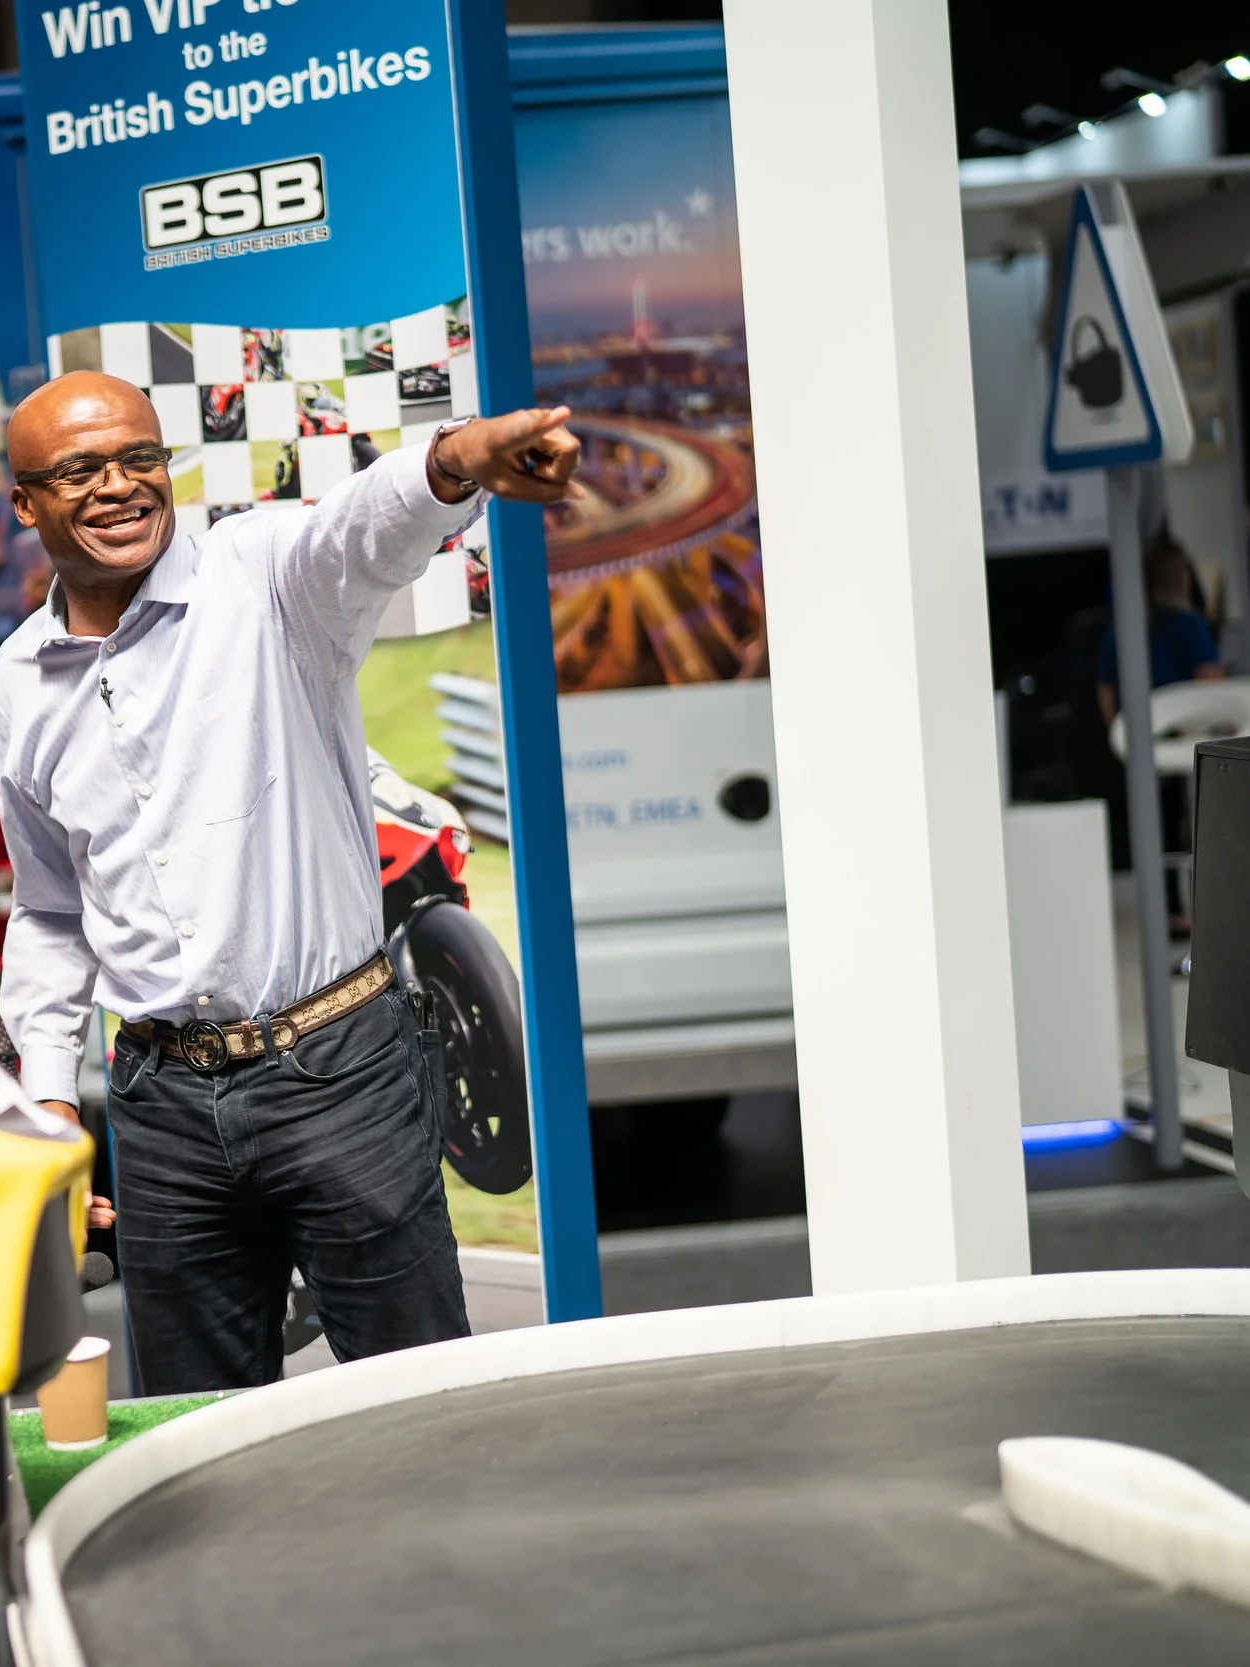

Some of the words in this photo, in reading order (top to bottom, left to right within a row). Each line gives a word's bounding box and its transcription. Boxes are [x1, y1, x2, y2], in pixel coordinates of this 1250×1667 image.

[42, 2, 132, 58] Win
[143, 0, 222, 35] VIP
[182, 42, 213, 70] to
[219, 31, 267, 63] the
[47, 93, 174, 155] British
[184, 46, 432, 126] Superbikes
[144, 160, 323, 248] BSB
[145, 247, 212, 270] BRITISH
[215, 226, 329, 258] SUPERBIKES
